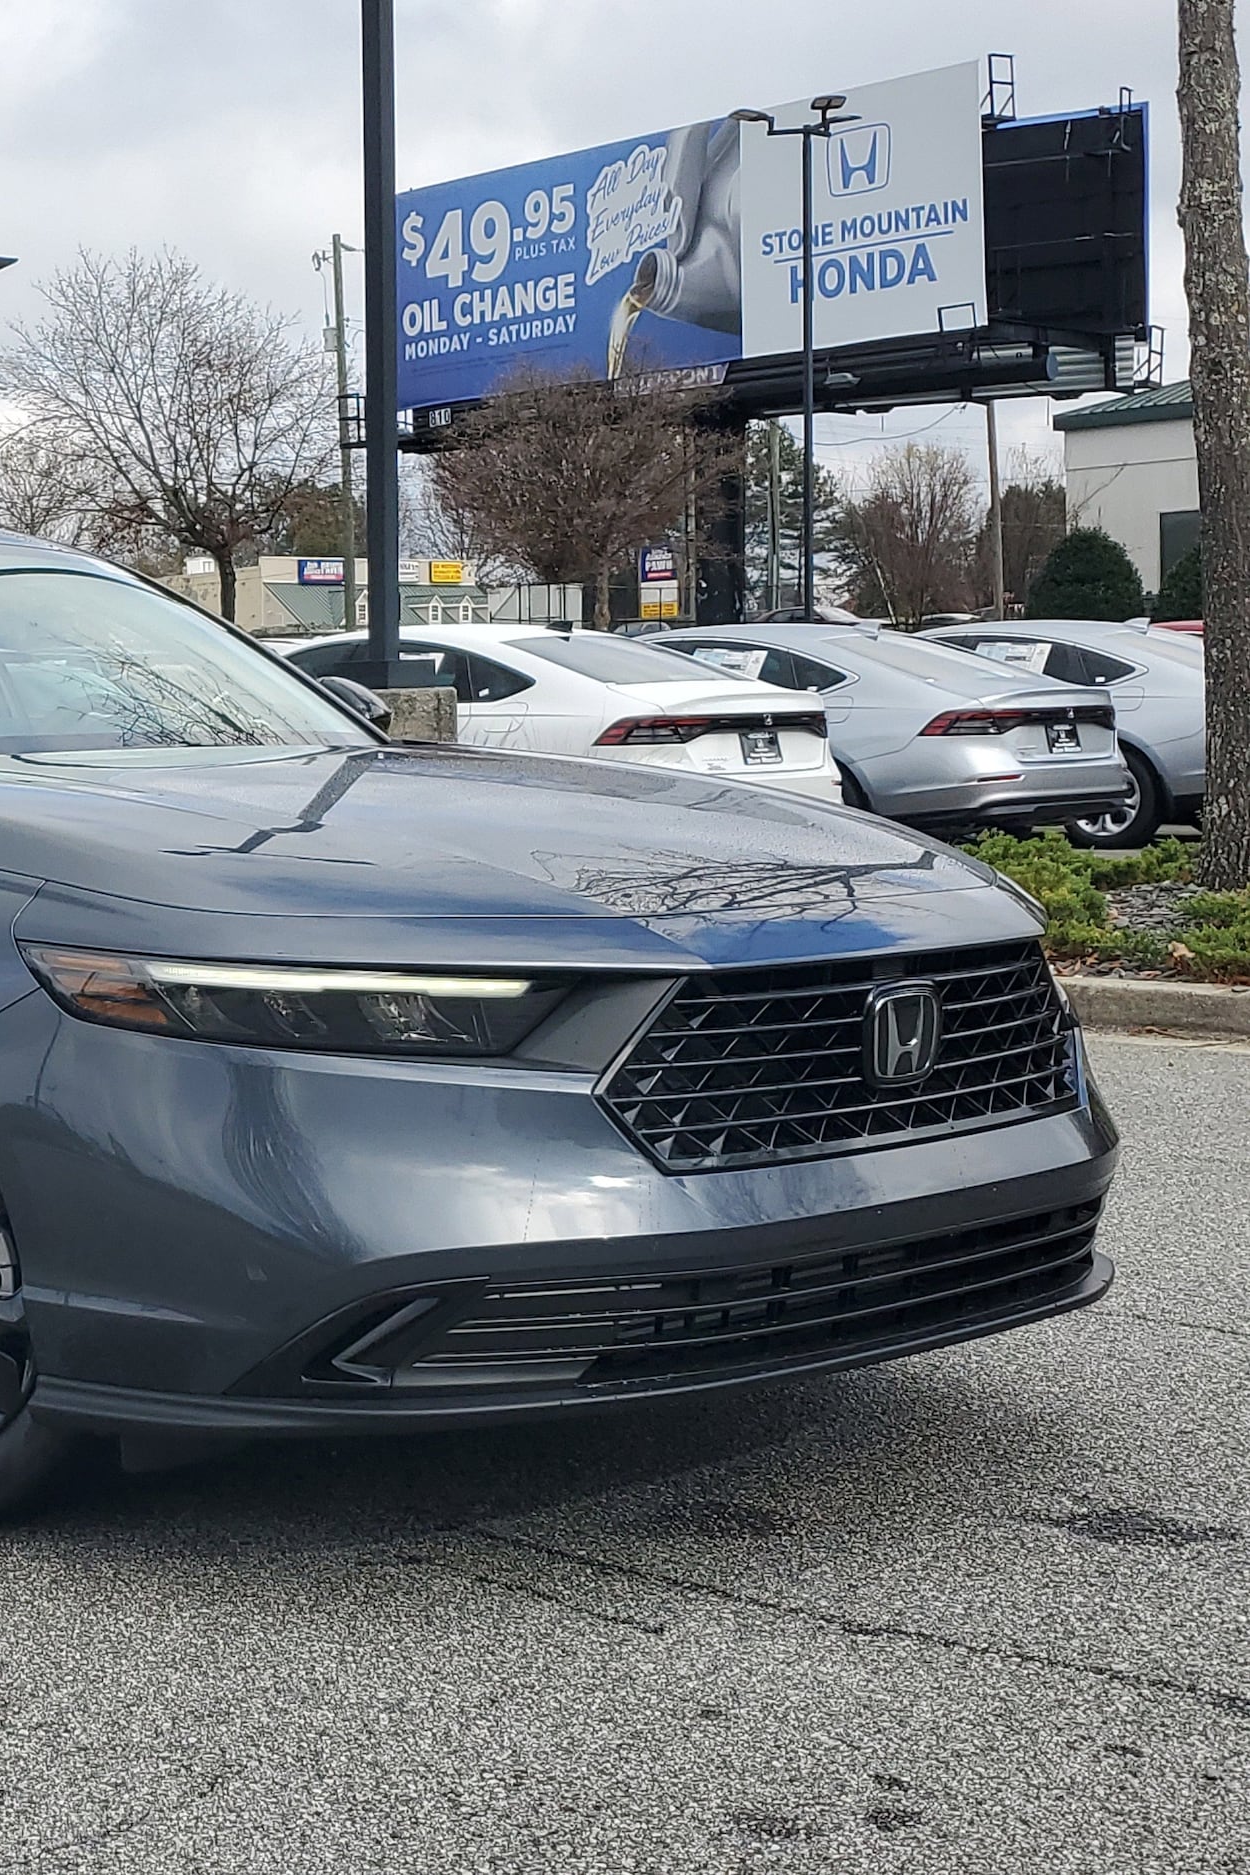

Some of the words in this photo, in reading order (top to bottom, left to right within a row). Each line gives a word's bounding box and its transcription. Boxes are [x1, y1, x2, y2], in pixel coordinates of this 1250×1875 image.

[591, 165, 622, 210] All
[626, 150, 660, 185] Day
[402, 183, 576, 288] $49.95
[590, 248, 621, 279] Low
[625, 202, 678, 258] Prices!
[591, 186, 662, 243] Everyday
[761, 222, 833, 256] STONE
[841, 198, 968, 242] MOUNTAIN
[515, 240, 547, 261] PLUS
[551, 236, 577, 255] TAX
[790, 242, 937, 304] HONDA
[402, 299, 447, 337] OIL
[453, 273, 576, 327] CHANGE
[405, 332, 471, 361] MONDAY
[488, 313, 577, 346] SATURDAY
